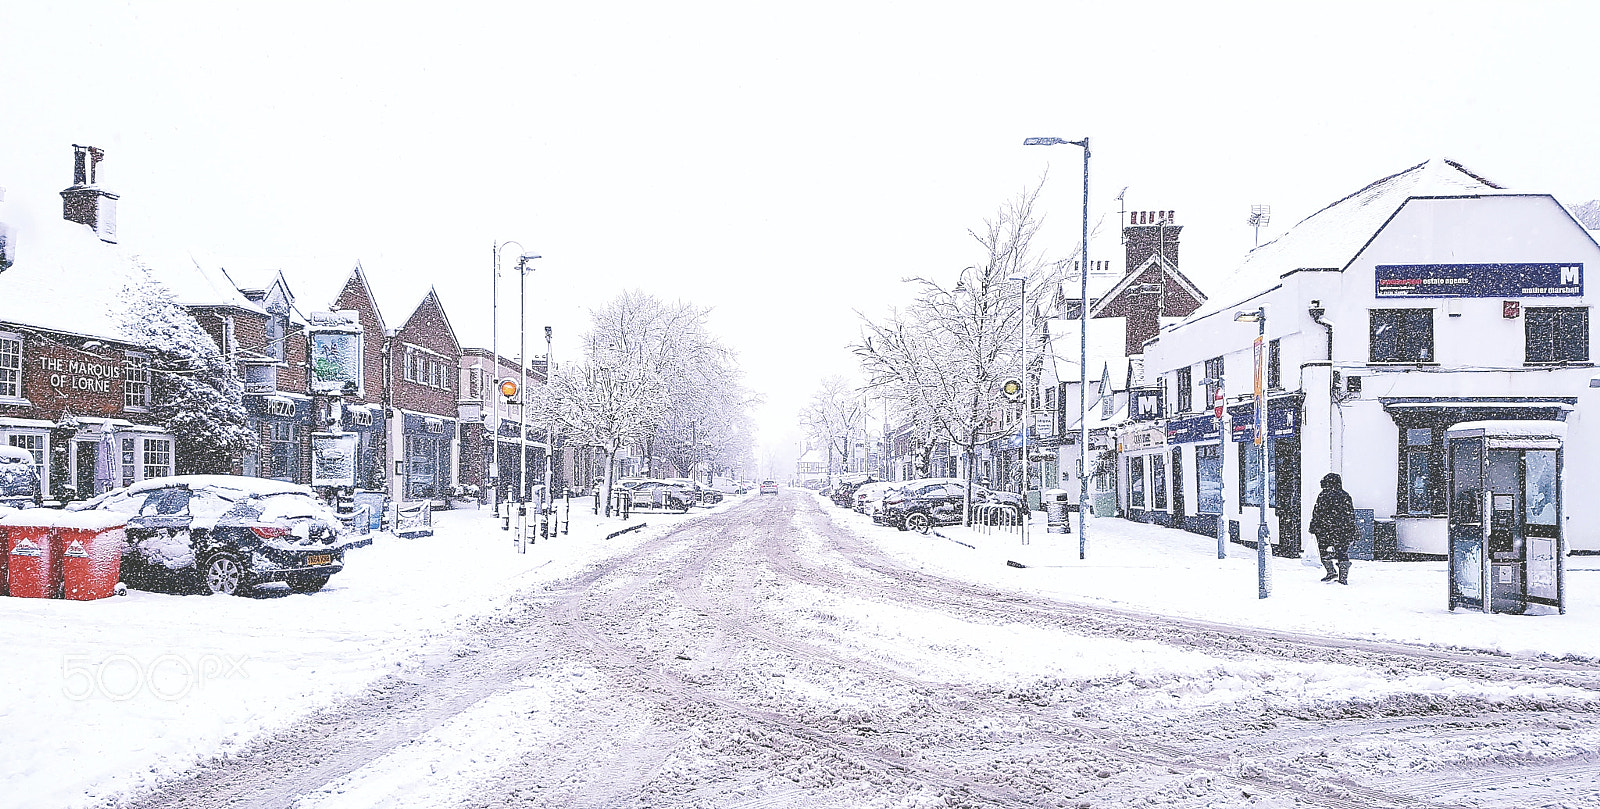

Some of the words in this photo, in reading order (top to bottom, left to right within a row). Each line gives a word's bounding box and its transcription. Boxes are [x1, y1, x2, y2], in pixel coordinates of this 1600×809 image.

[1422, 277, 1444, 286] estate
[1445, 277, 1469, 286] agents
[1560, 266, 1579, 285] M
[1521, 286, 1547, 294] mother
[1548, 286, 1580, 295] marshall
[40, 356, 63, 372] THE
[68, 360, 120, 379] MARQUIS
[51, 373, 67, 388] OF
[72, 376, 110, 393] LORNE
[267, 398, 296, 418] PREZZO
[1137, 395, 1158, 415] M
